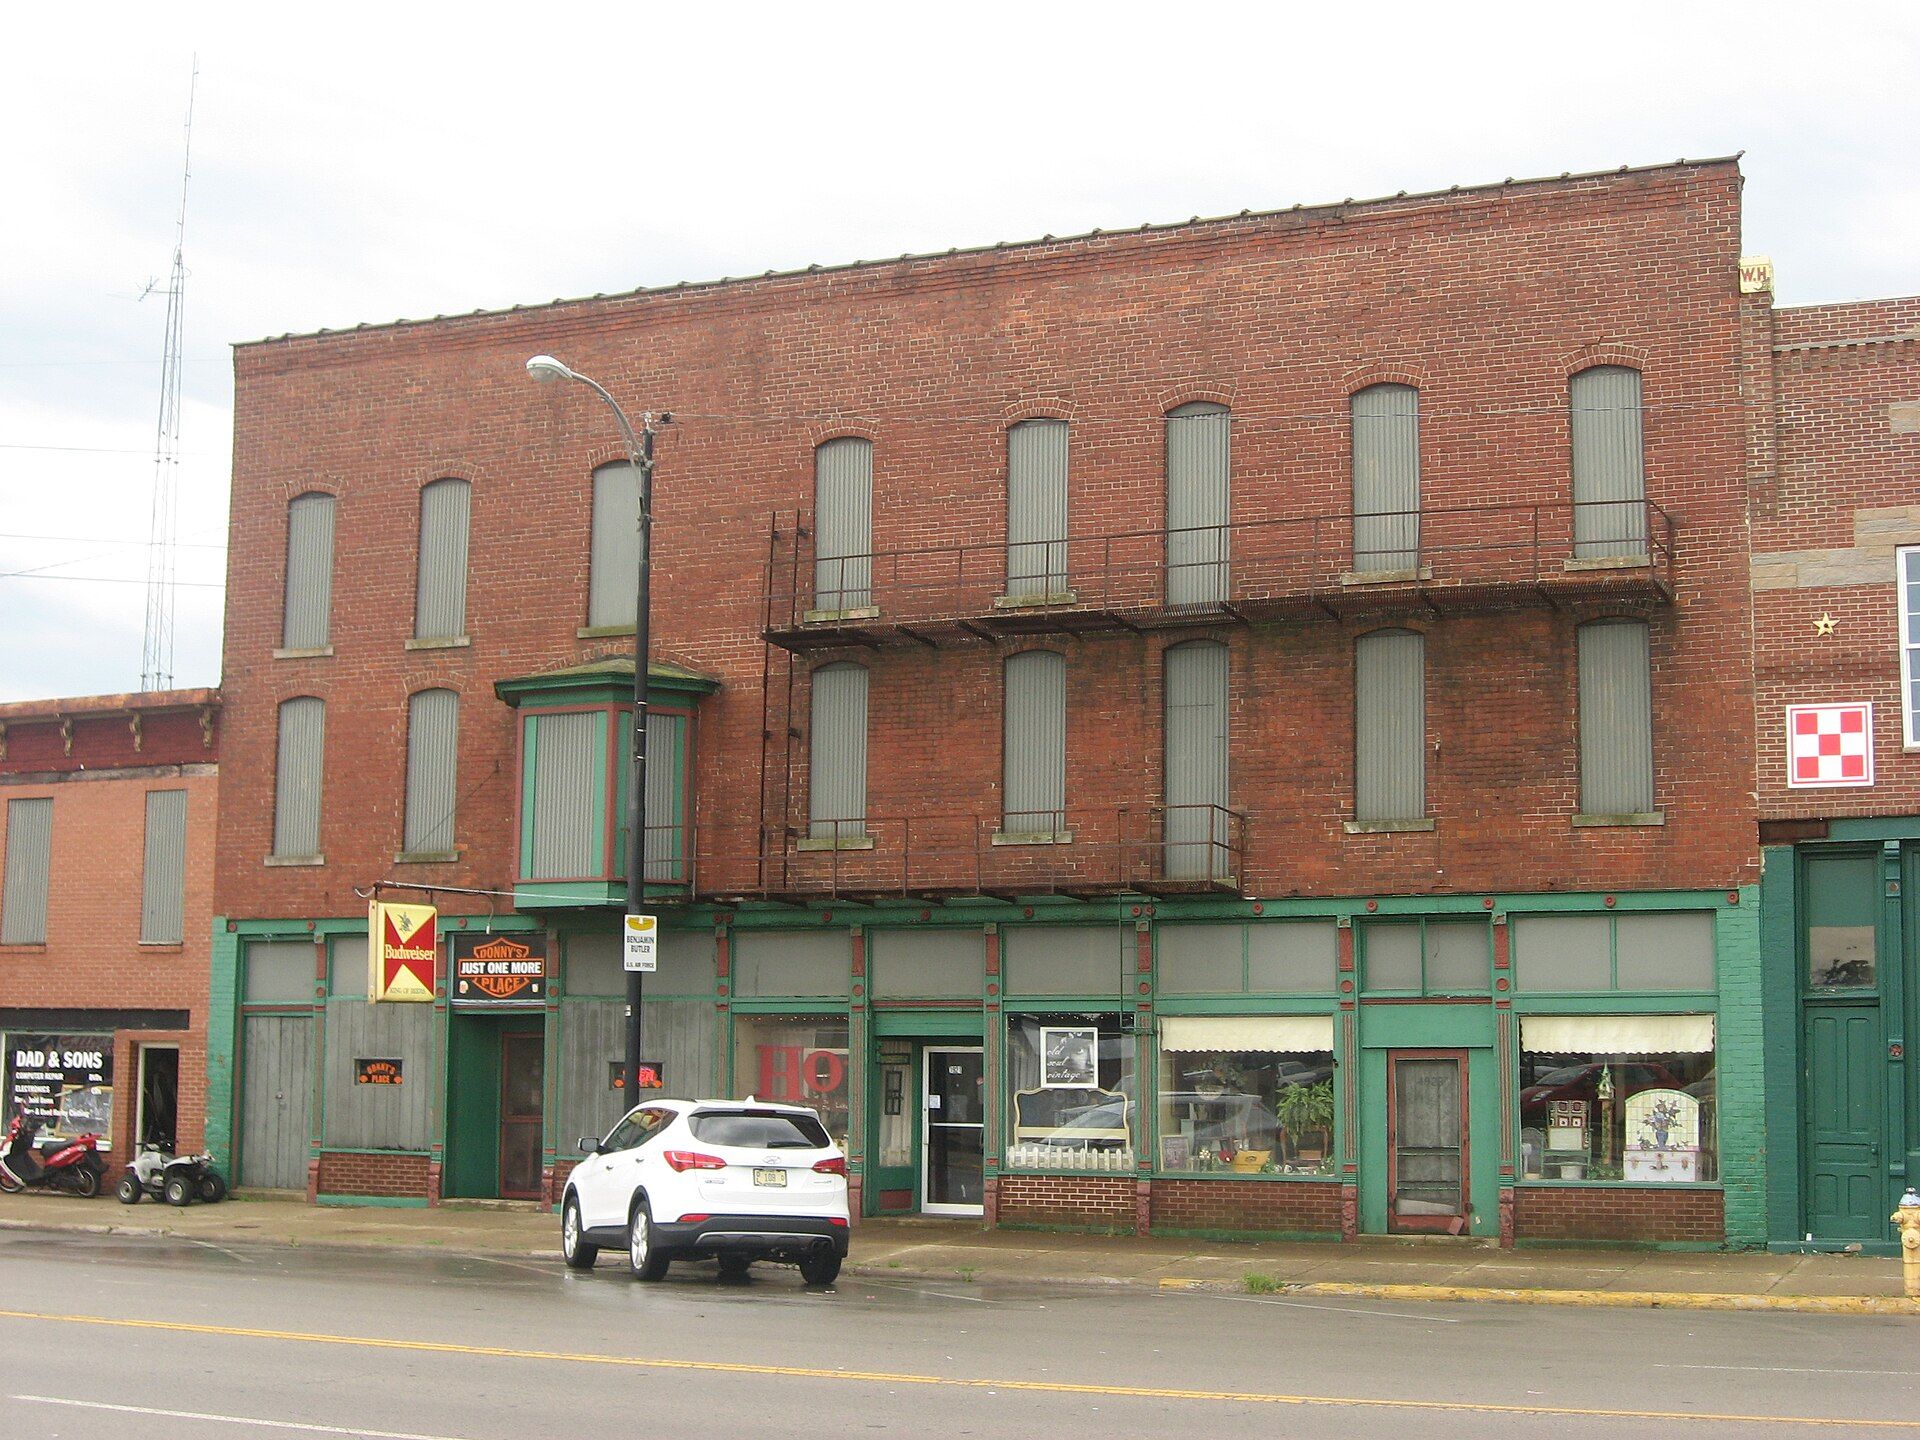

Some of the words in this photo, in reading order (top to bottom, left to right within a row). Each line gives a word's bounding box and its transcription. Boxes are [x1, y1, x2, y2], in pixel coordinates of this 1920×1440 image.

[626, 935, 655, 944] BENJAMIN
[385, 944, 435, 960] Budweiser
[480, 946, 523, 958] DONNY'S
[630, 945, 651, 953] BUTLER
[461, 962, 486, 974] JUST
[487, 962, 510, 974] ONE
[511, 962, 542, 974] MORE
[481, 977, 520, 993] PLACE
[1046, 1045, 1065, 1056] old
[16, 1050, 45, 1067] DAD
[48, 1051, 60, 1068] &
[63, 1051, 103, 1069] SONS
[15, 1072, 44, 1080] COMPUTER
[45, 1072, 65, 1080] REPAIR
[1046, 1069, 1081, 1083] vintage
[15, 1085, 51, 1093] ELECTRONICS
